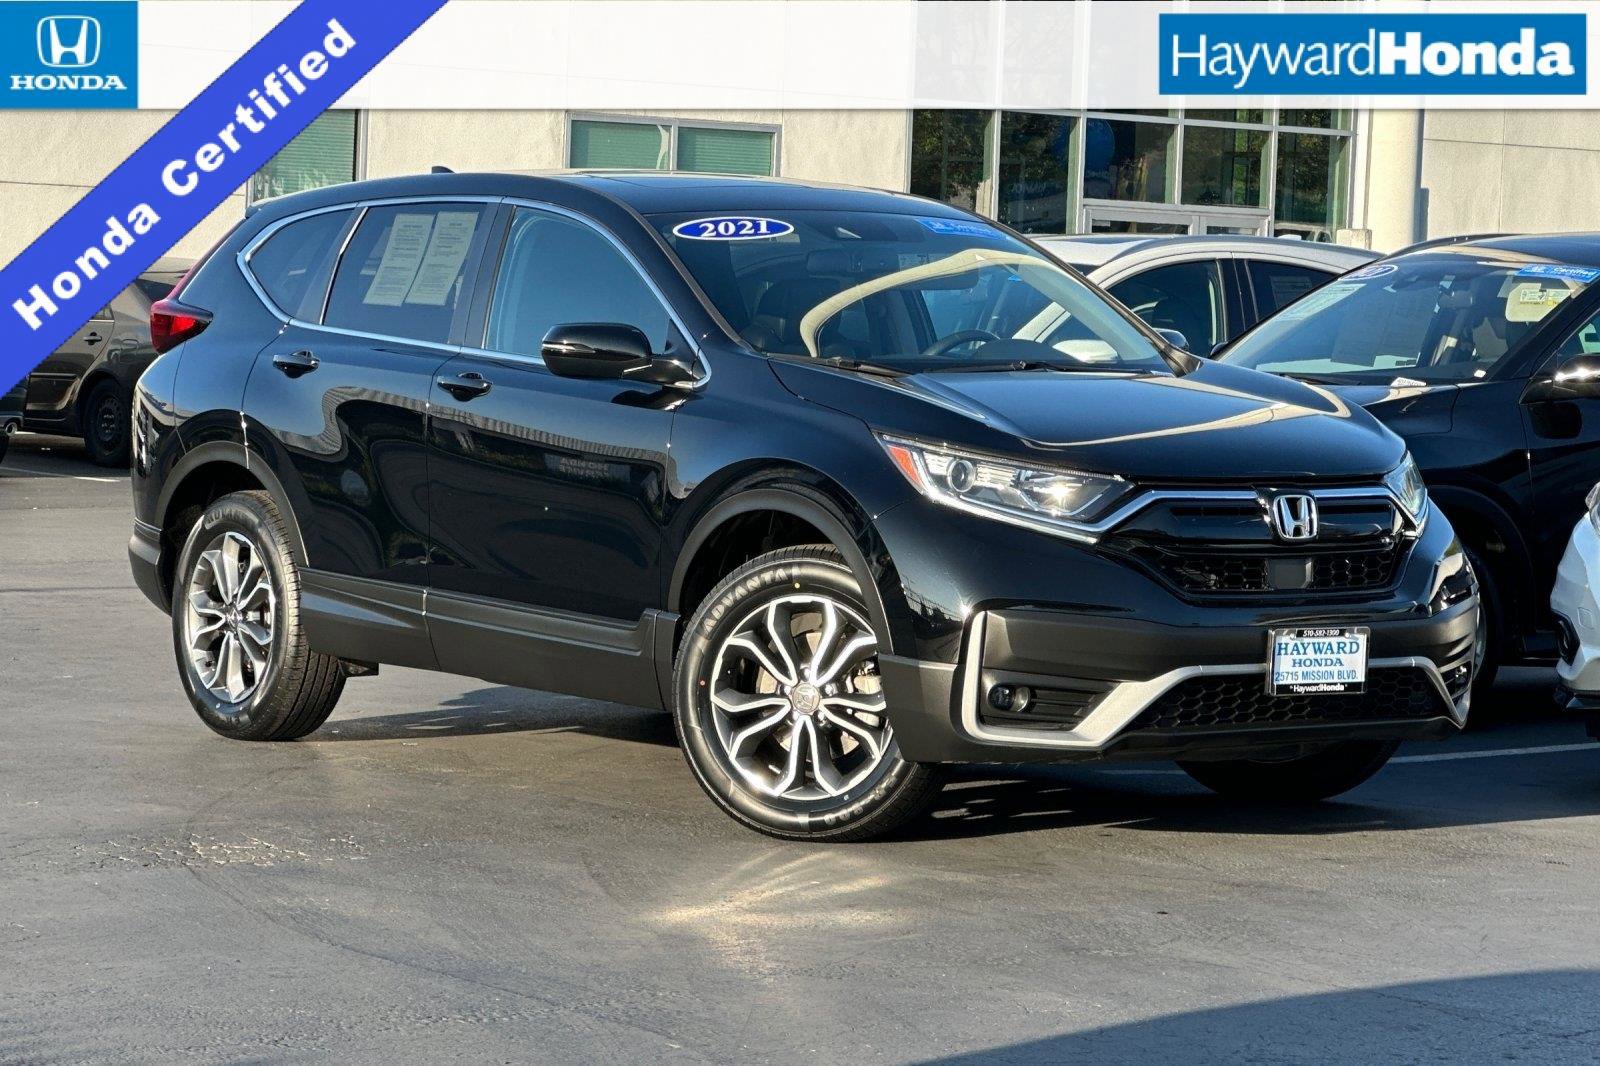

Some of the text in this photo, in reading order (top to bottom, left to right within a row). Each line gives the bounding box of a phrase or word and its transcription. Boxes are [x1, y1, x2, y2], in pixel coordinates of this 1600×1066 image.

[699, 220, 771, 237] 2021
[703, 568, 789, 635] ADVANTA
[1276, 641, 1360, 656] HAYWARD
[1291, 658, 1344, 668] HONDA
[1275, 671, 1299, 682] 25715
[1301, 670, 1335, 681] MISSION
